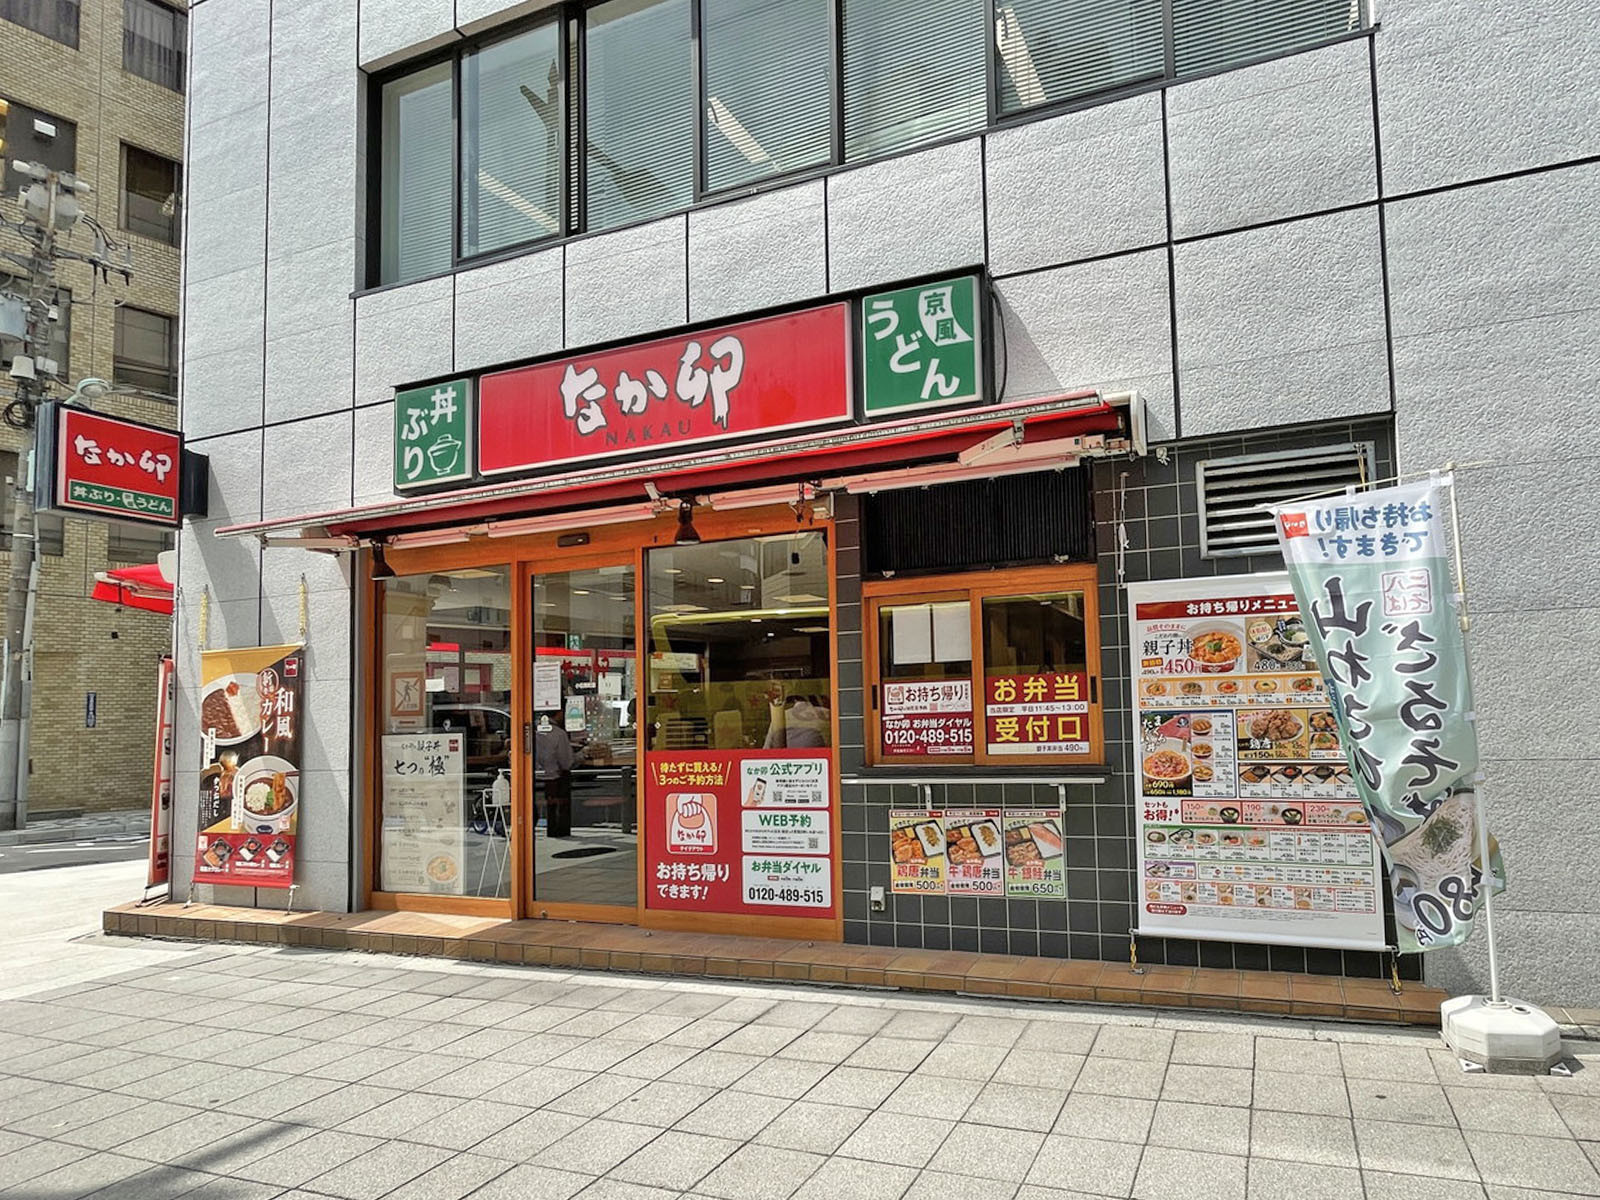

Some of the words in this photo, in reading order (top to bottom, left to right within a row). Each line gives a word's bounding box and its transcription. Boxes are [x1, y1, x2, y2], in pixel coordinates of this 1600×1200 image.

[924, 291, 957, 341] 京風
[866, 301, 961, 400] うどん
[558, 334, 745, 434] なか卯
[606, 420, 692, 447] NAKAU
[73, 434, 173, 483] なか卯
[1186, 598, 1299, 616] お持ち帰りメニュー
[1143, 638, 1193, 656] 親子丼
[905, 685, 964, 702] お持ち帰り
[993, 674, 1079, 702] お弁当
[261, 698, 274, 753] カレー
[995, 715, 1082, 742] 受付口
[884, 729, 973, 745] 0120-489-515
[758, 813, 812, 828] WEB予約
[677, 829, 707, 844] なか卯
[656, 862, 730, 882] お持ち帰り
[751, 860, 822, 874] お弁当ダイヤル
[748, 887, 824, 904] 0120-489-515
